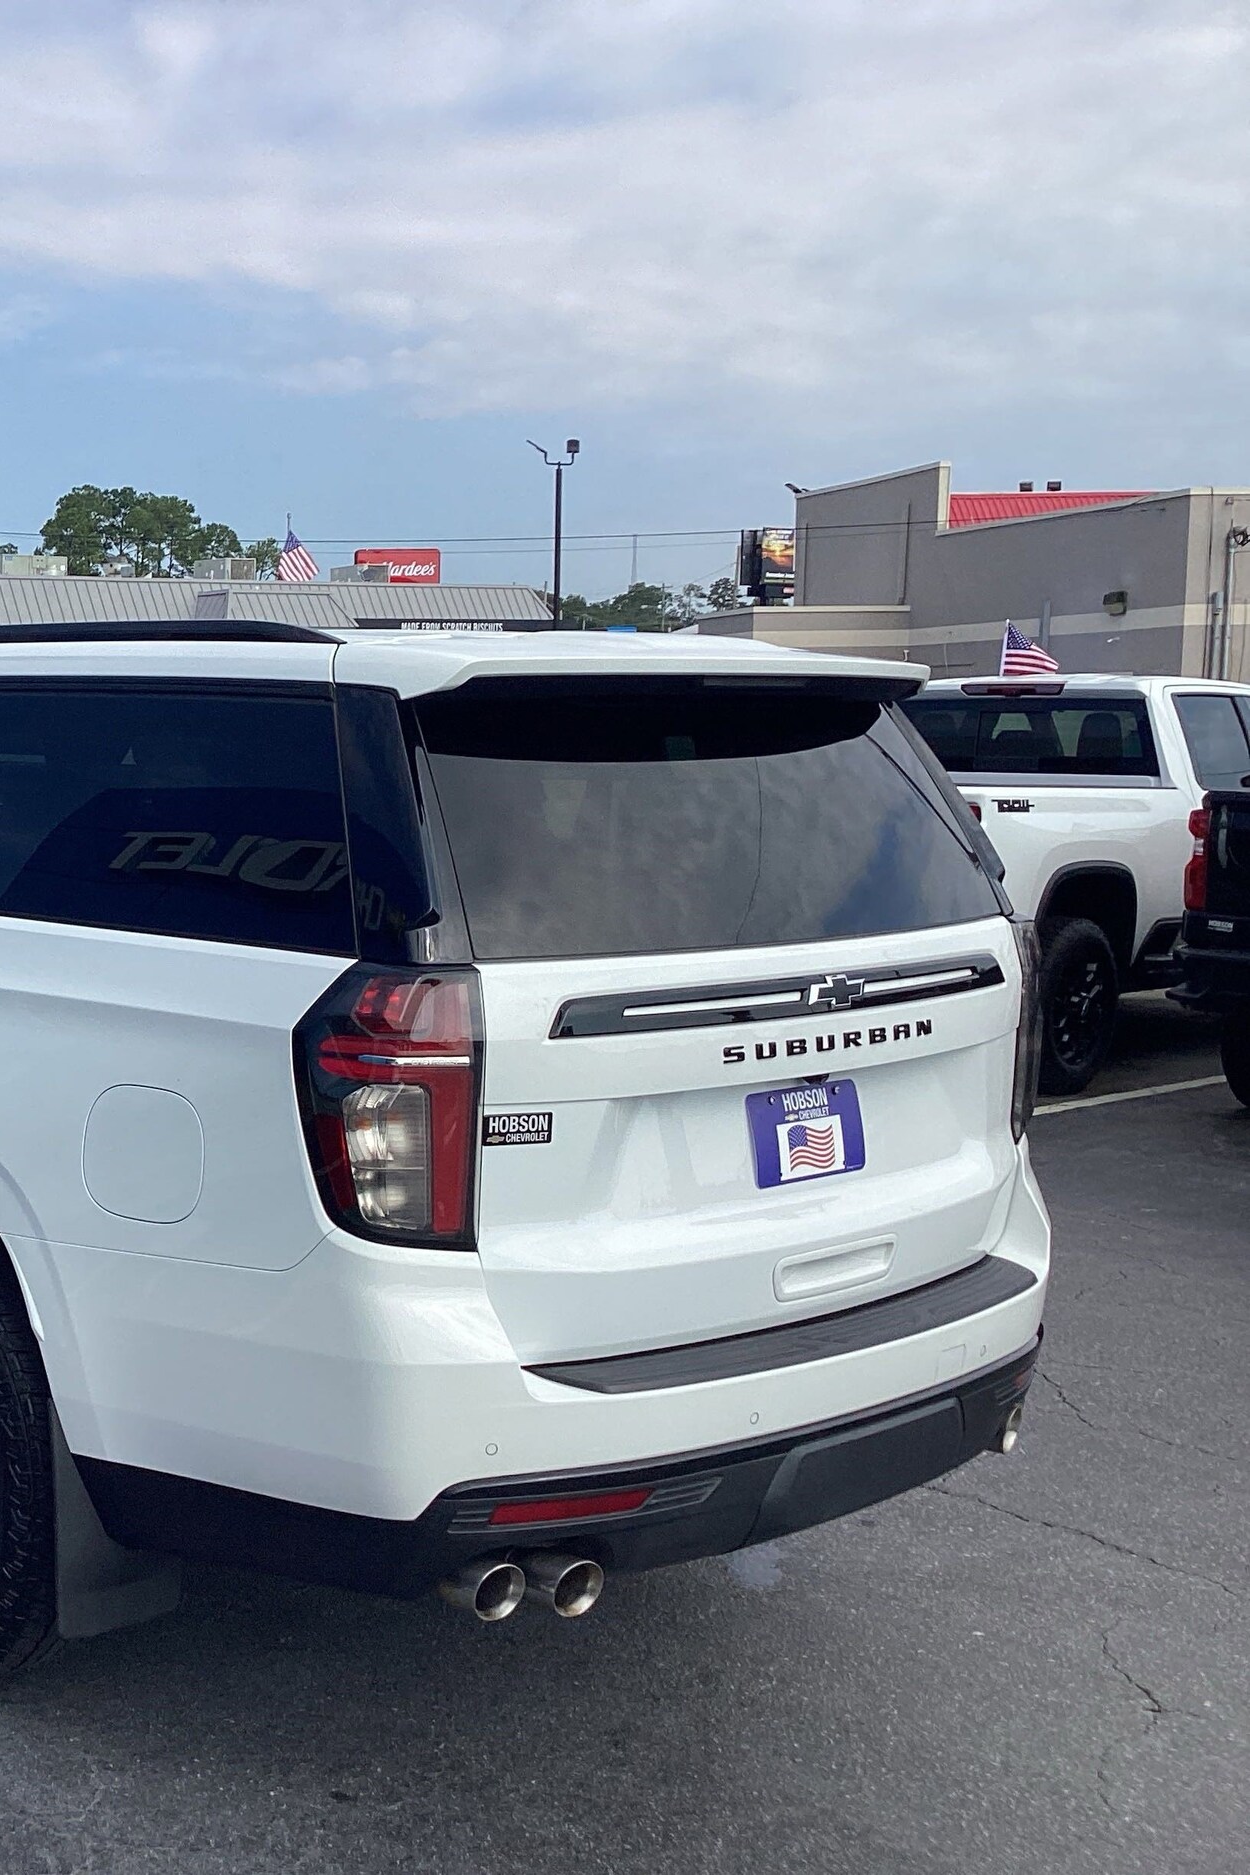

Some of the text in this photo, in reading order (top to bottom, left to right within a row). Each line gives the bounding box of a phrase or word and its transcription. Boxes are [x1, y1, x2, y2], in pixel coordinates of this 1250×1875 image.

[723, 1019, 933, 1064] SUBURBAN
[781, 1087, 828, 1111] HOBSON
[799, 1106, 829, 1120] CHEVROLET
[488, 1114, 549, 1133] HOBSON
[506, 1132, 549, 1143] CHEVROLET
